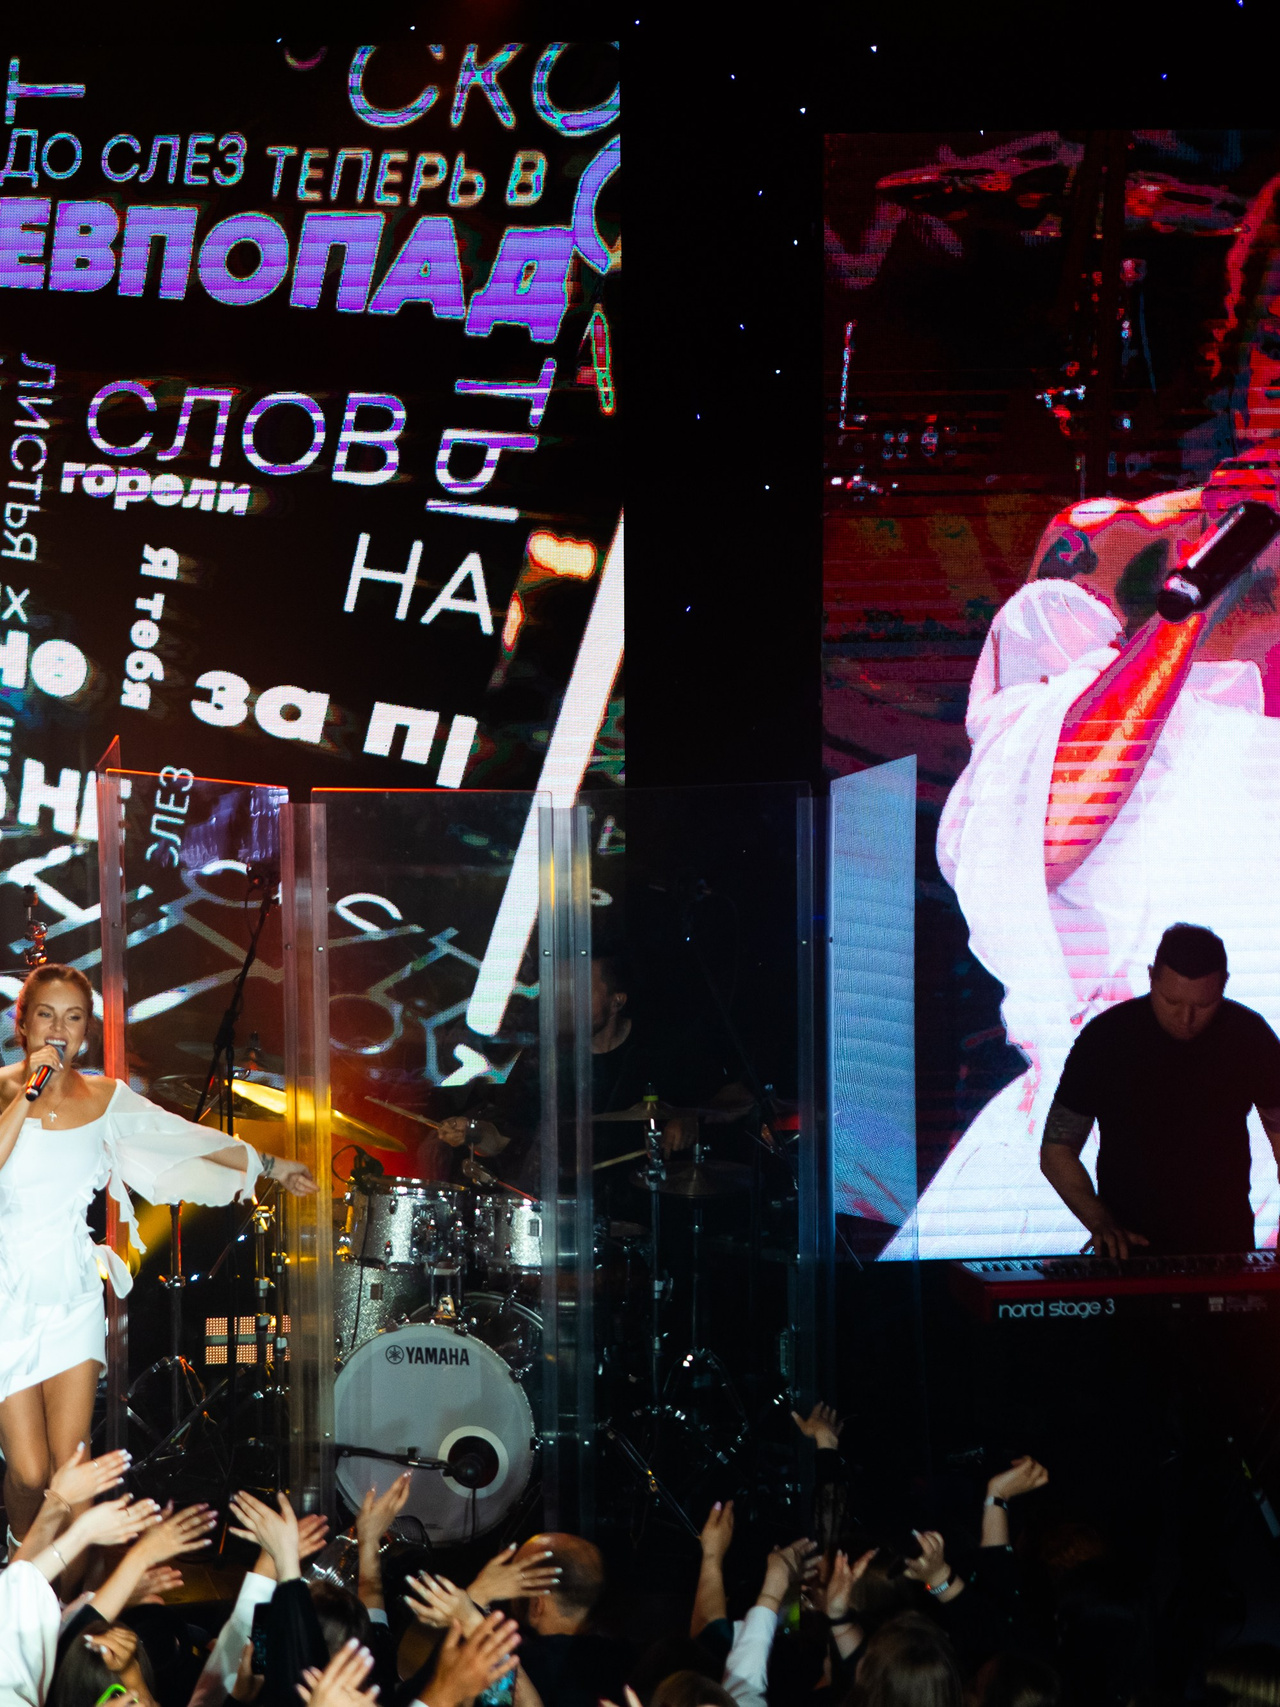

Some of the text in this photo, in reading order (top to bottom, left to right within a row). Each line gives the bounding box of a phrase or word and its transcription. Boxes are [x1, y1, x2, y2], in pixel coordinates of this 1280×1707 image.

[101, 132, 248, 187] СЛЕЗ
[267, 146, 486, 208] ТЕПЕРЬ
[505, 150, 549, 207] В
[0, 352, 57, 561] ЛИСТЬЯ
[86, 380, 408, 486] СЛОВ
[424, 357, 557, 523] ТЫ
[998, 1298, 1116, 1319] nord stage 3
[406, 1346, 470, 1366] YAMAHA
